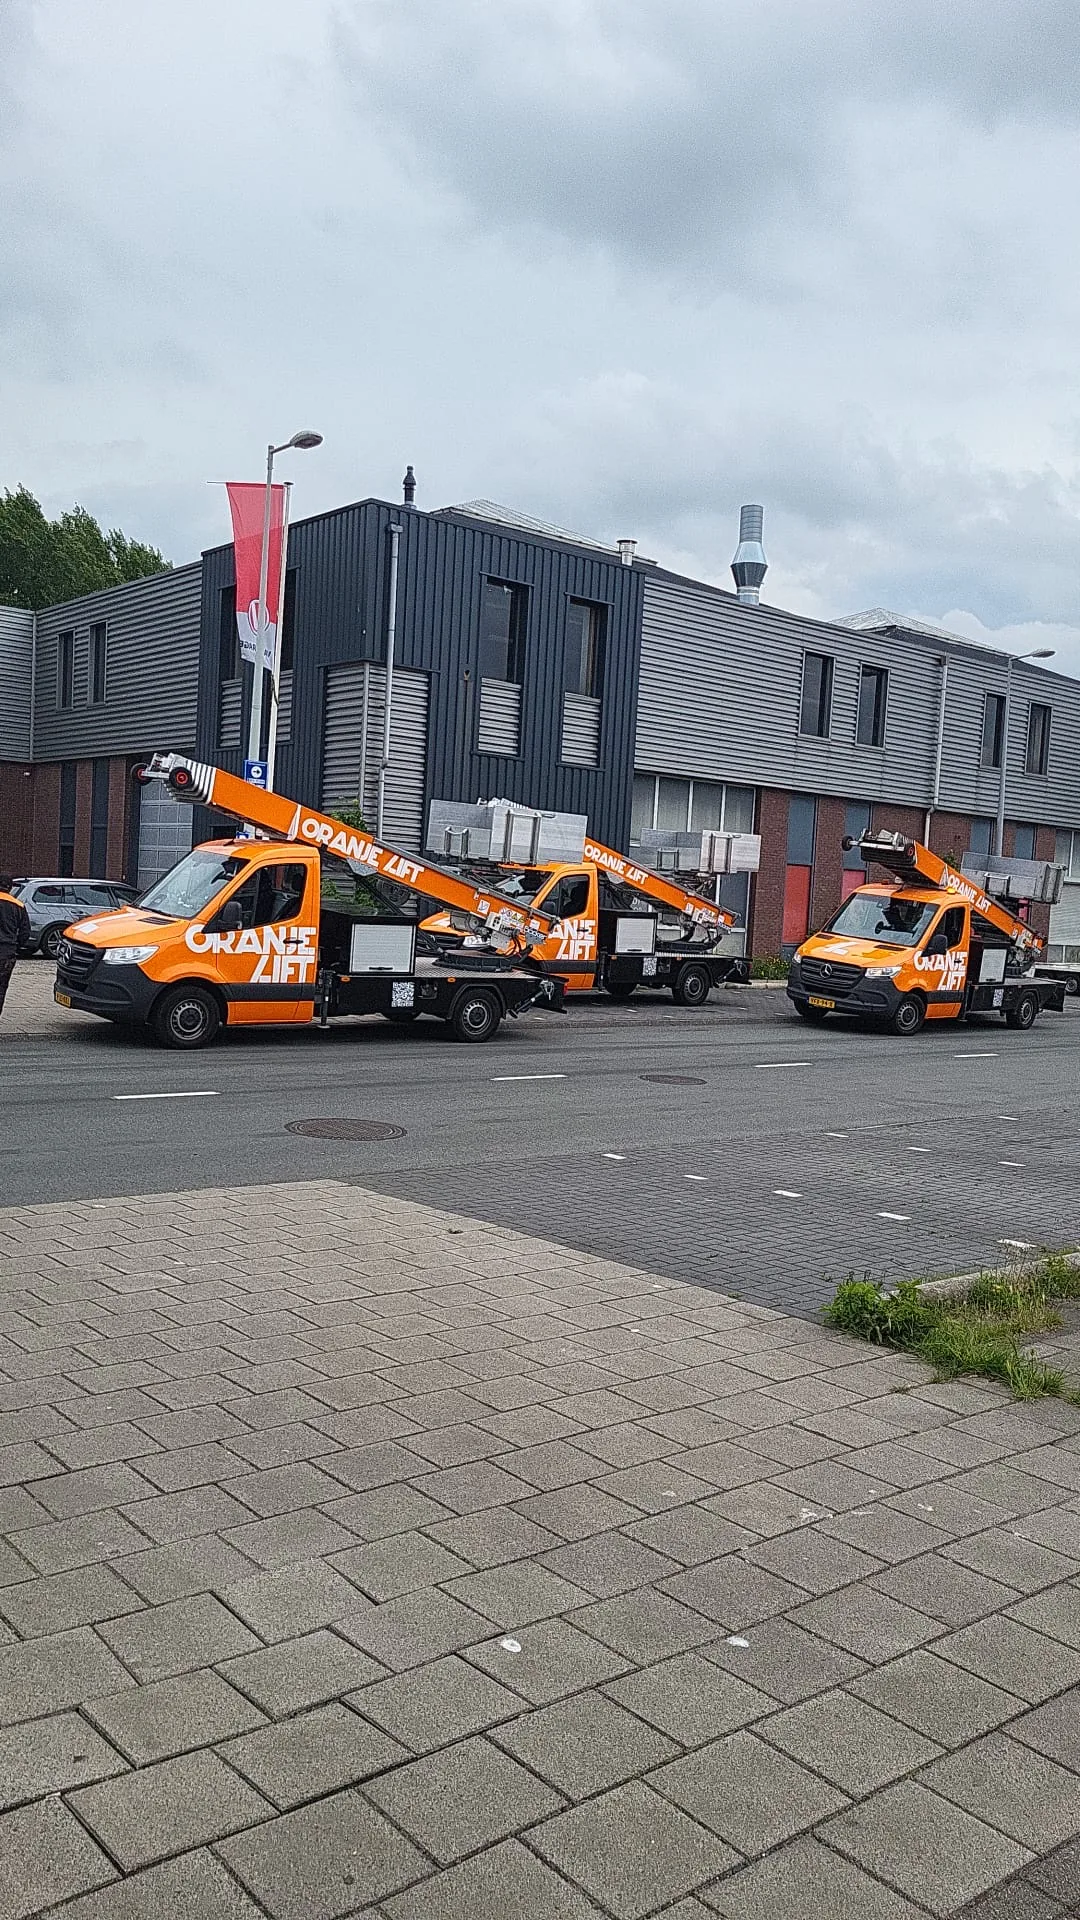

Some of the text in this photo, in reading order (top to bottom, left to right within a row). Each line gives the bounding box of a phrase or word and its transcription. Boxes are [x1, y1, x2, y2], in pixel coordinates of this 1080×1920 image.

[302, 818, 424, 883] ORANJE LIFT
[584, 845, 648, 885] ORANJE LIFT
[948, 874, 992, 913] ORANJE LIFT
[185, 924, 316, 955] ORANJE
[548, 920, 595, 940] ANJE
[556, 940, 594, 960] LIFT
[914, 950, 967, 970] ORANJE
[250, 955, 315, 983] LIFT
[937, 971, 965, 990] LIFT
